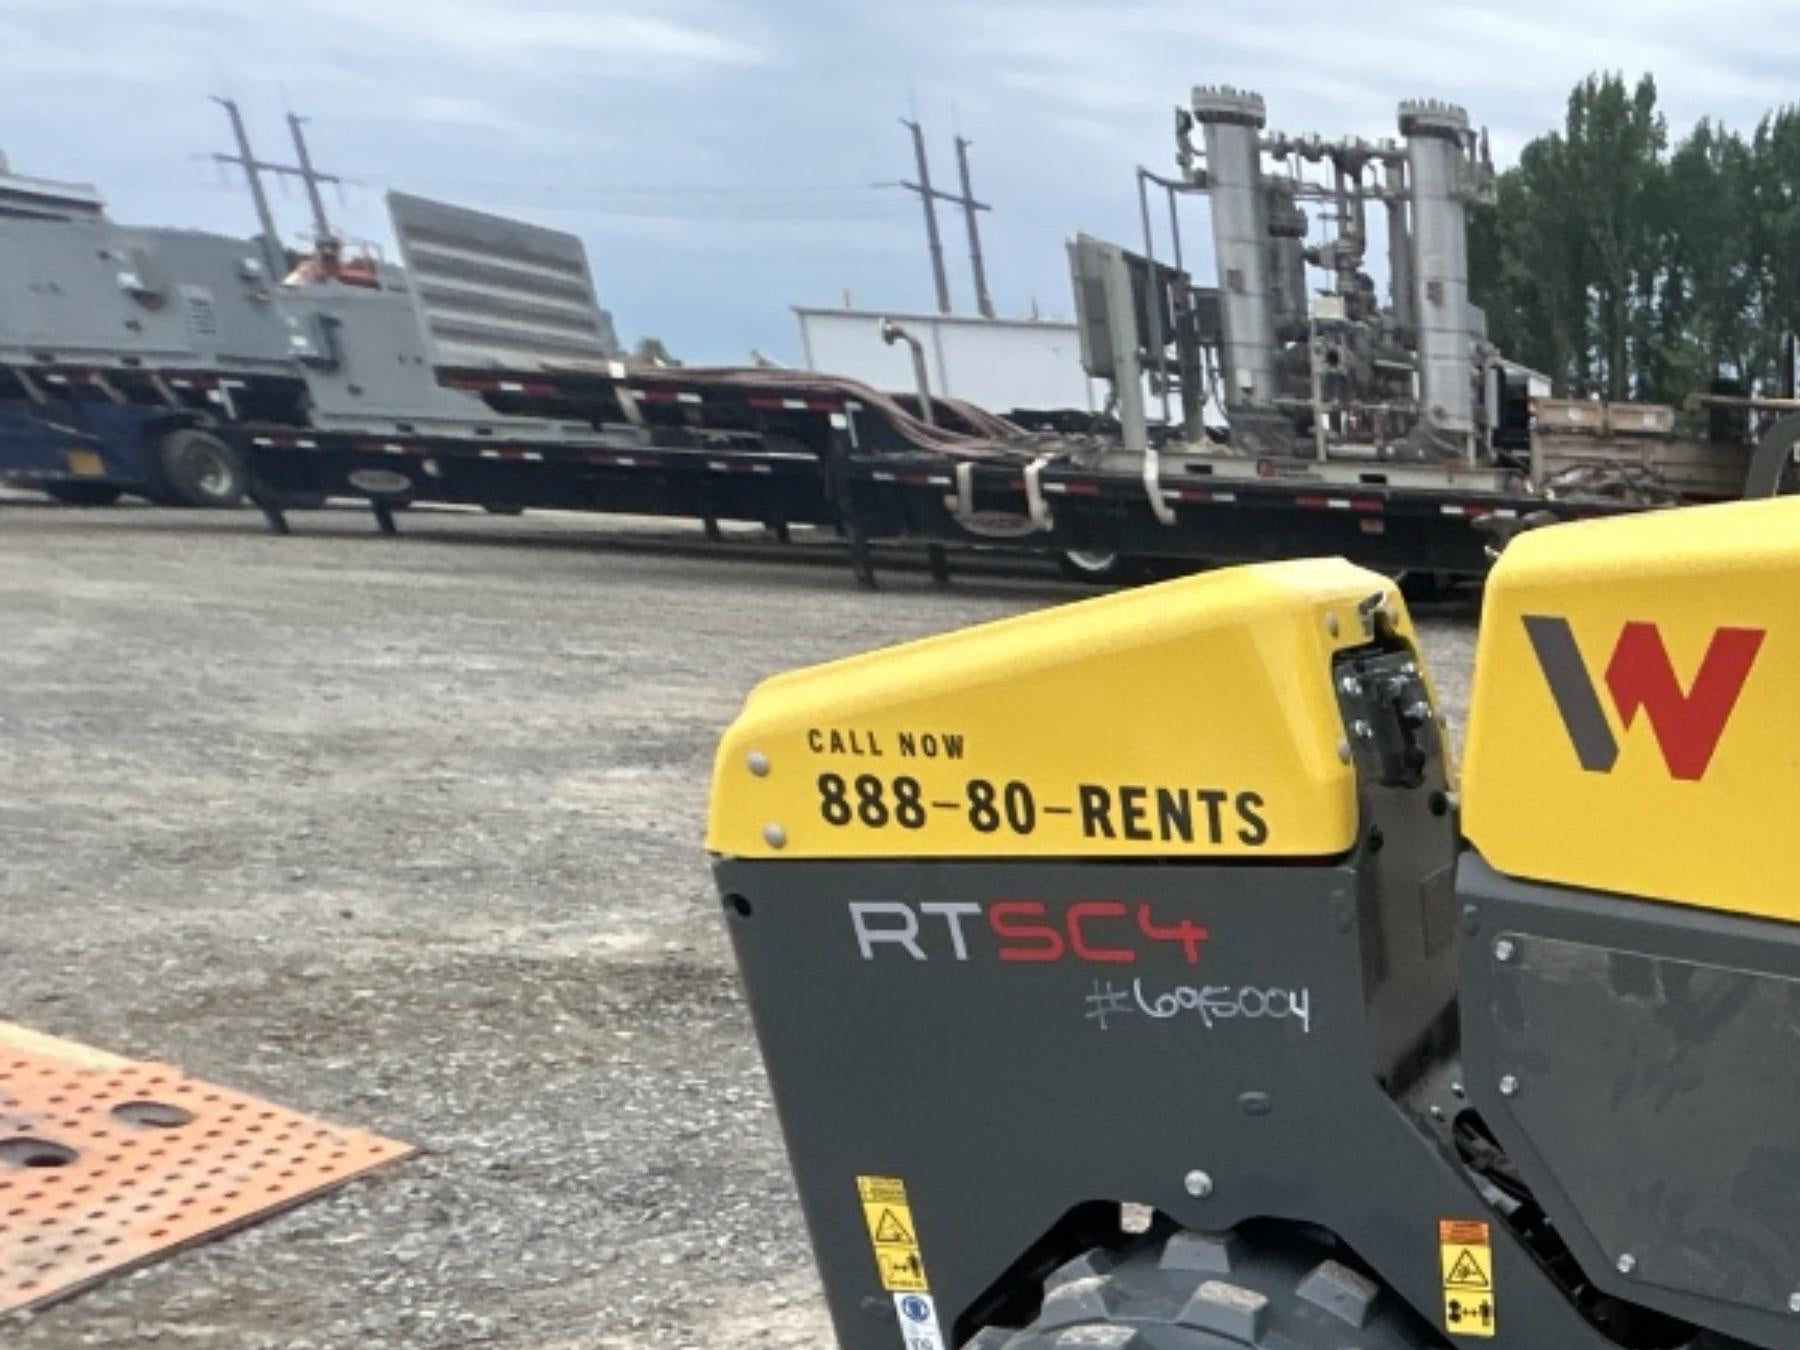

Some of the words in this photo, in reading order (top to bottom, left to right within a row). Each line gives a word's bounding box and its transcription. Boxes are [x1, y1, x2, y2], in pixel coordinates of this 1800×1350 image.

[808, 728, 884, 757] CALL
[899, 732, 965, 759] NOW
[817, 772, 1269, 846] 888-80-RENTS
[848, 900, 1209, 963] RTSC4
